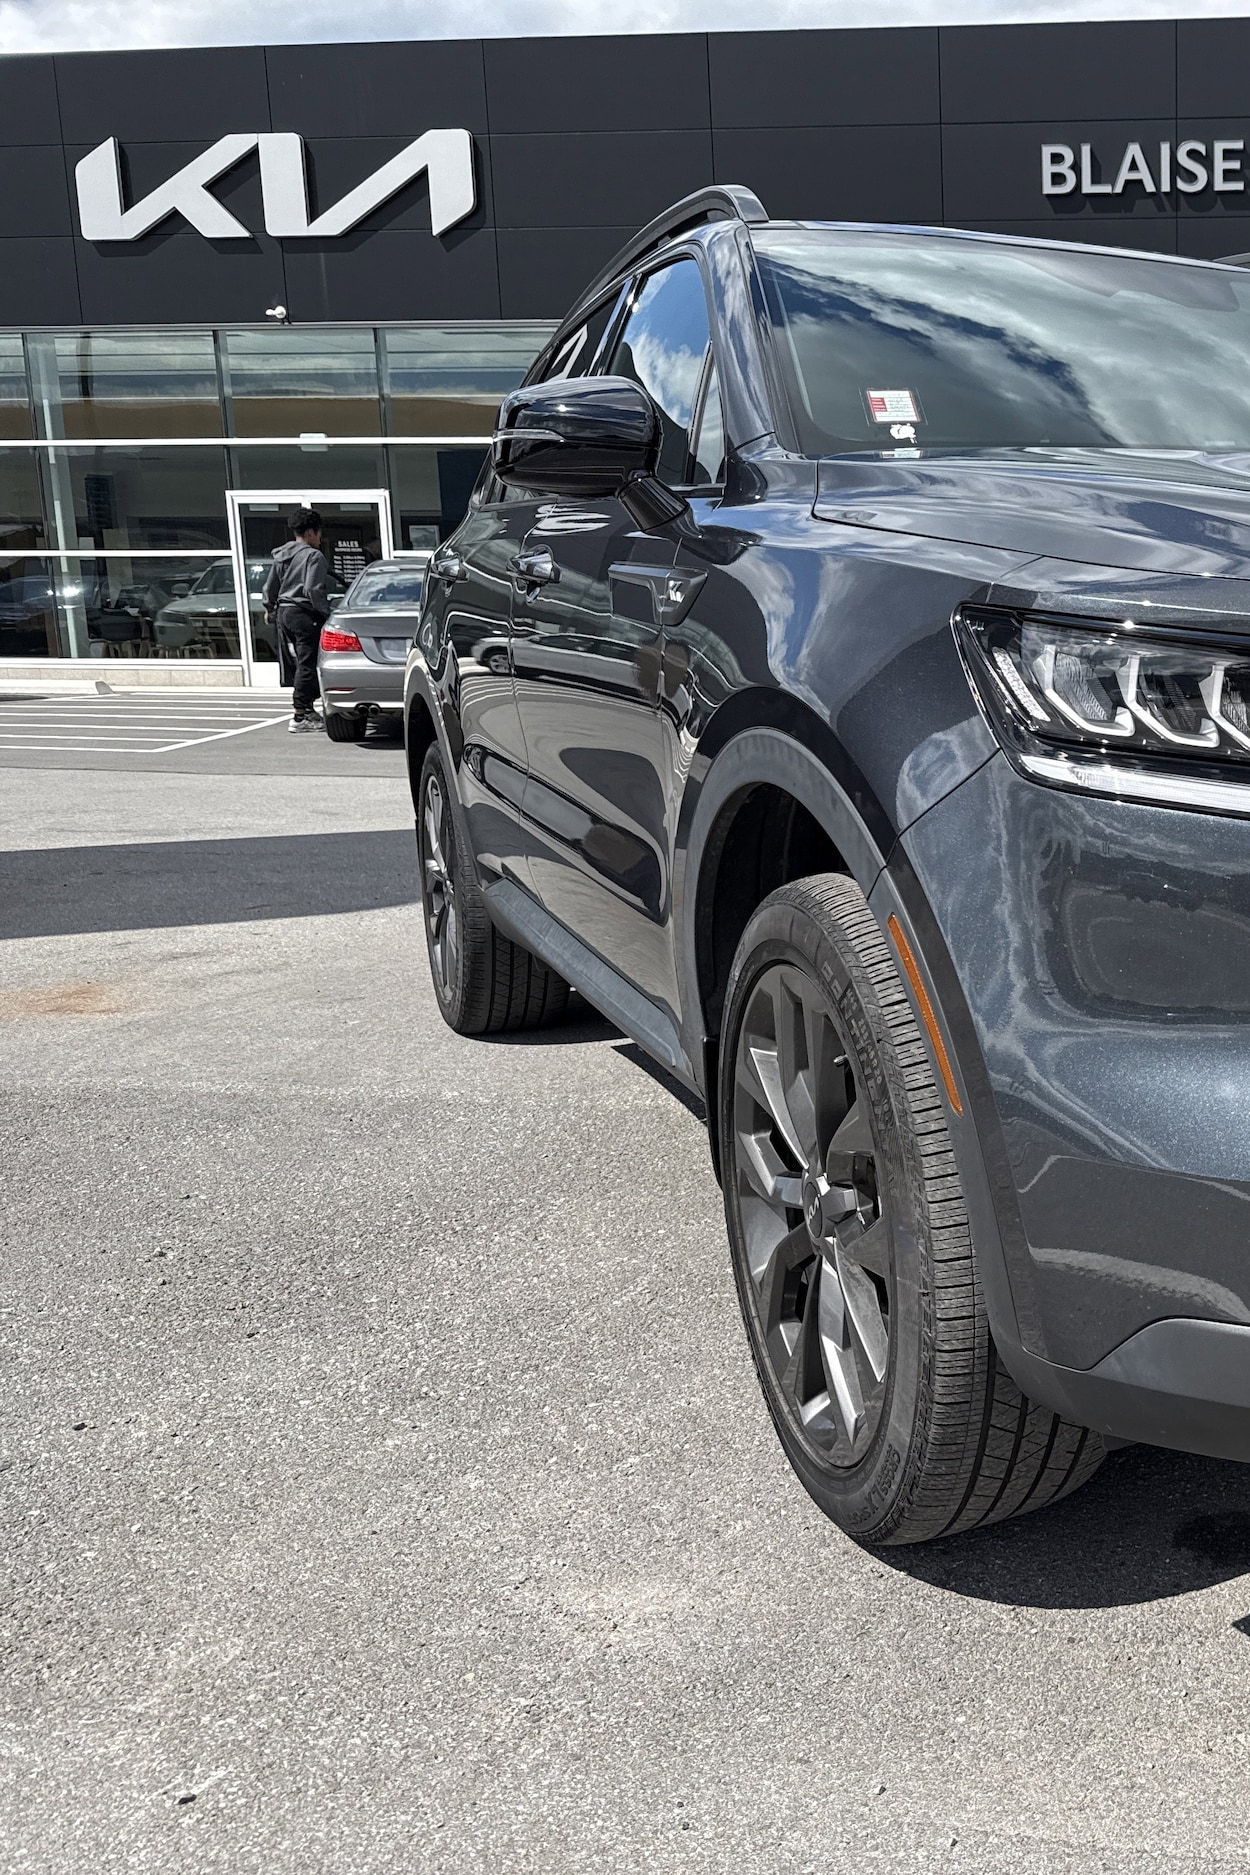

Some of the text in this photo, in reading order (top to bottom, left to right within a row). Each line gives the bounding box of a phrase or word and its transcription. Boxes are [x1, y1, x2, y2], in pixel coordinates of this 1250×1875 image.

[75, 128, 476, 241] KIA
[1041, 139, 1245, 194] BLAISE
[338, 540, 359, 548] SALES
